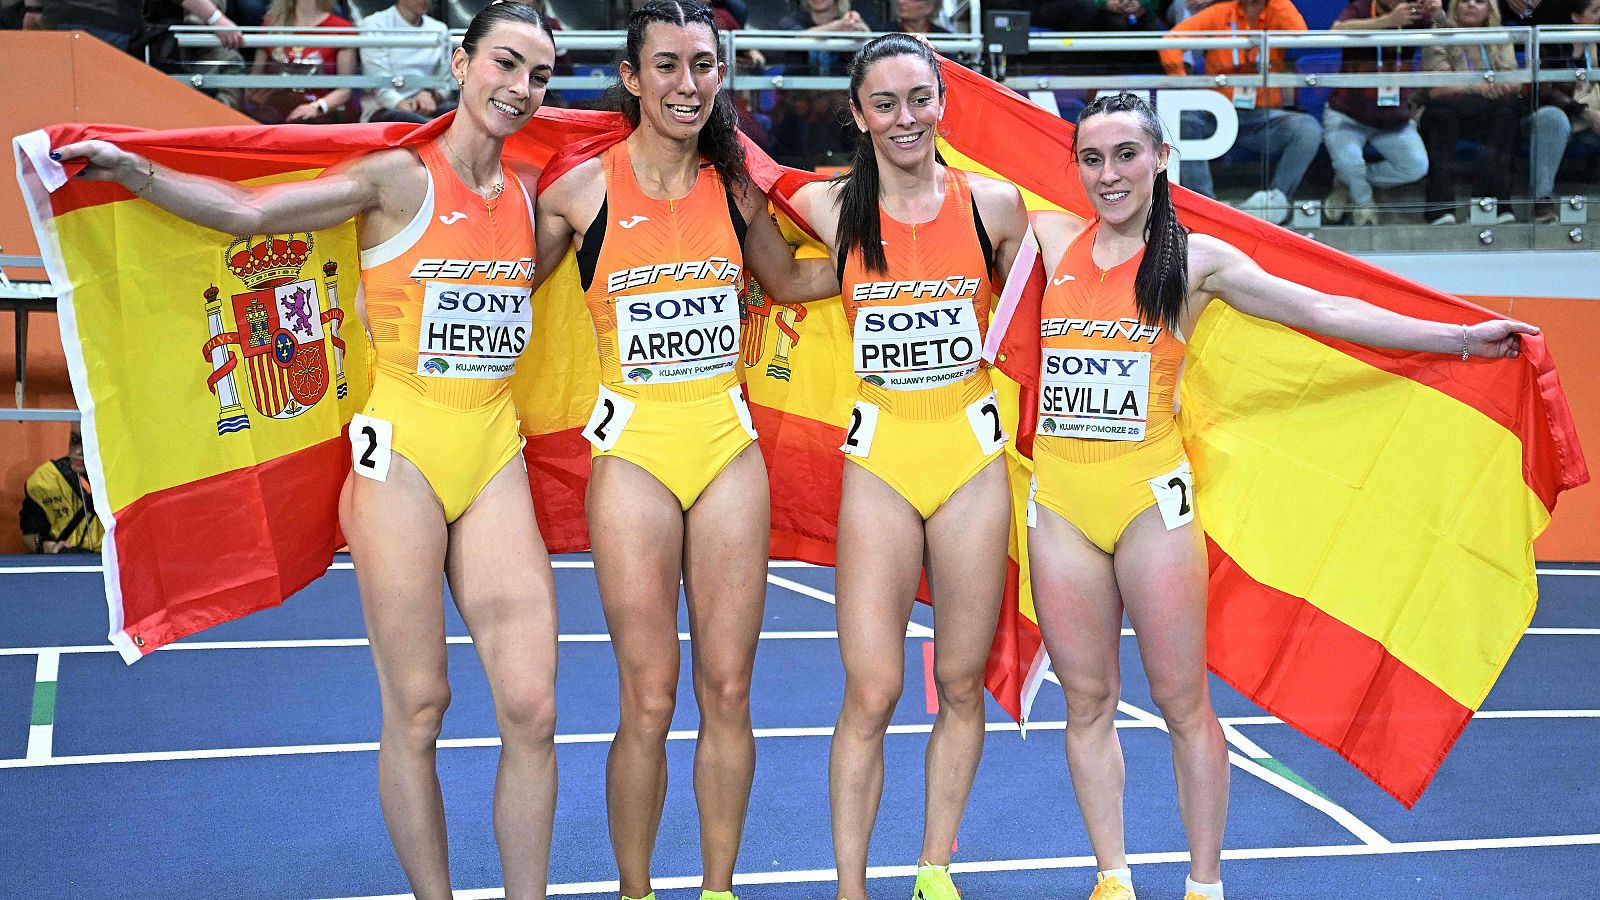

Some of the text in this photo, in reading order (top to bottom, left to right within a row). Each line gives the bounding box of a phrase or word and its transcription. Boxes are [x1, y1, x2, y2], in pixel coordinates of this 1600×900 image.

[608, 256, 741, 294] ESPAÑA
[853, 276, 981, 301] ESPAÑA
[438, 291, 526, 313] SONY
[629, 294, 727, 322] SONY
[865, 307, 962, 332] SONY
[427, 323, 526, 353] HERVAS
[628, 325, 735, 361] ARROYO
[862, 337, 973, 369] PRIETO
[455, 363, 487, 372] KUJAWY
[659, 367, 693, 377] KUJAWY
[890, 376, 925, 385] KUJAWY
[926, 371, 964, 382] POMORZE
[1046, 355, 1138, 377] SONY
[1043, 386, 1139, 416] SEVILLA
[594, 399, 614, 441] 2
[847, 407, 862, 447] 2
[981, 404, 1002, 442] 2
[1059, 423, 1139, 435] KUJAWY POMORZE 26
[360, 426, 377, 469] 2
[1168, 477, 1190, 516] 2
